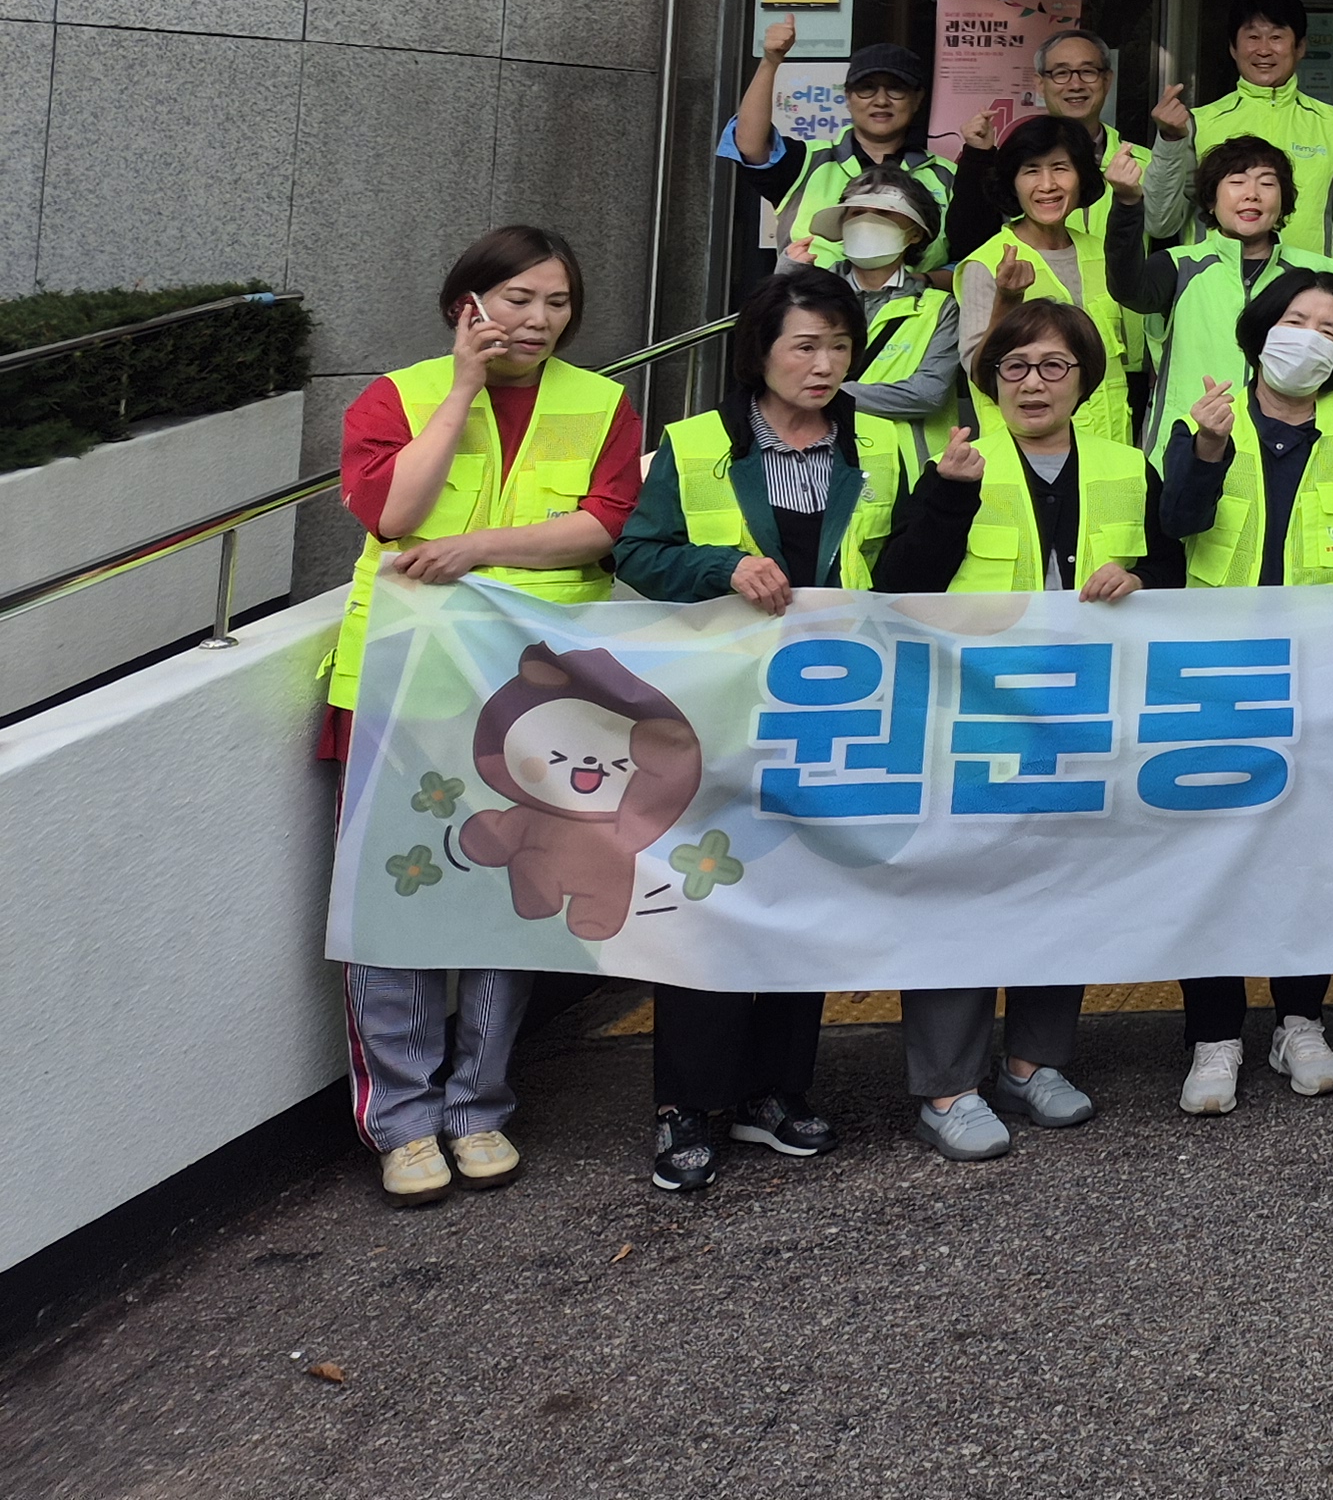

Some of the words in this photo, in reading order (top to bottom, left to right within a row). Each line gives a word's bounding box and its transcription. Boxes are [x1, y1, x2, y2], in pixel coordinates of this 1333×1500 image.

[944, 20, 1009, 33] 과천시민
[943, 34, 1025, 48] 체육대축전
[755, 636, 1296, 818] 원문동
